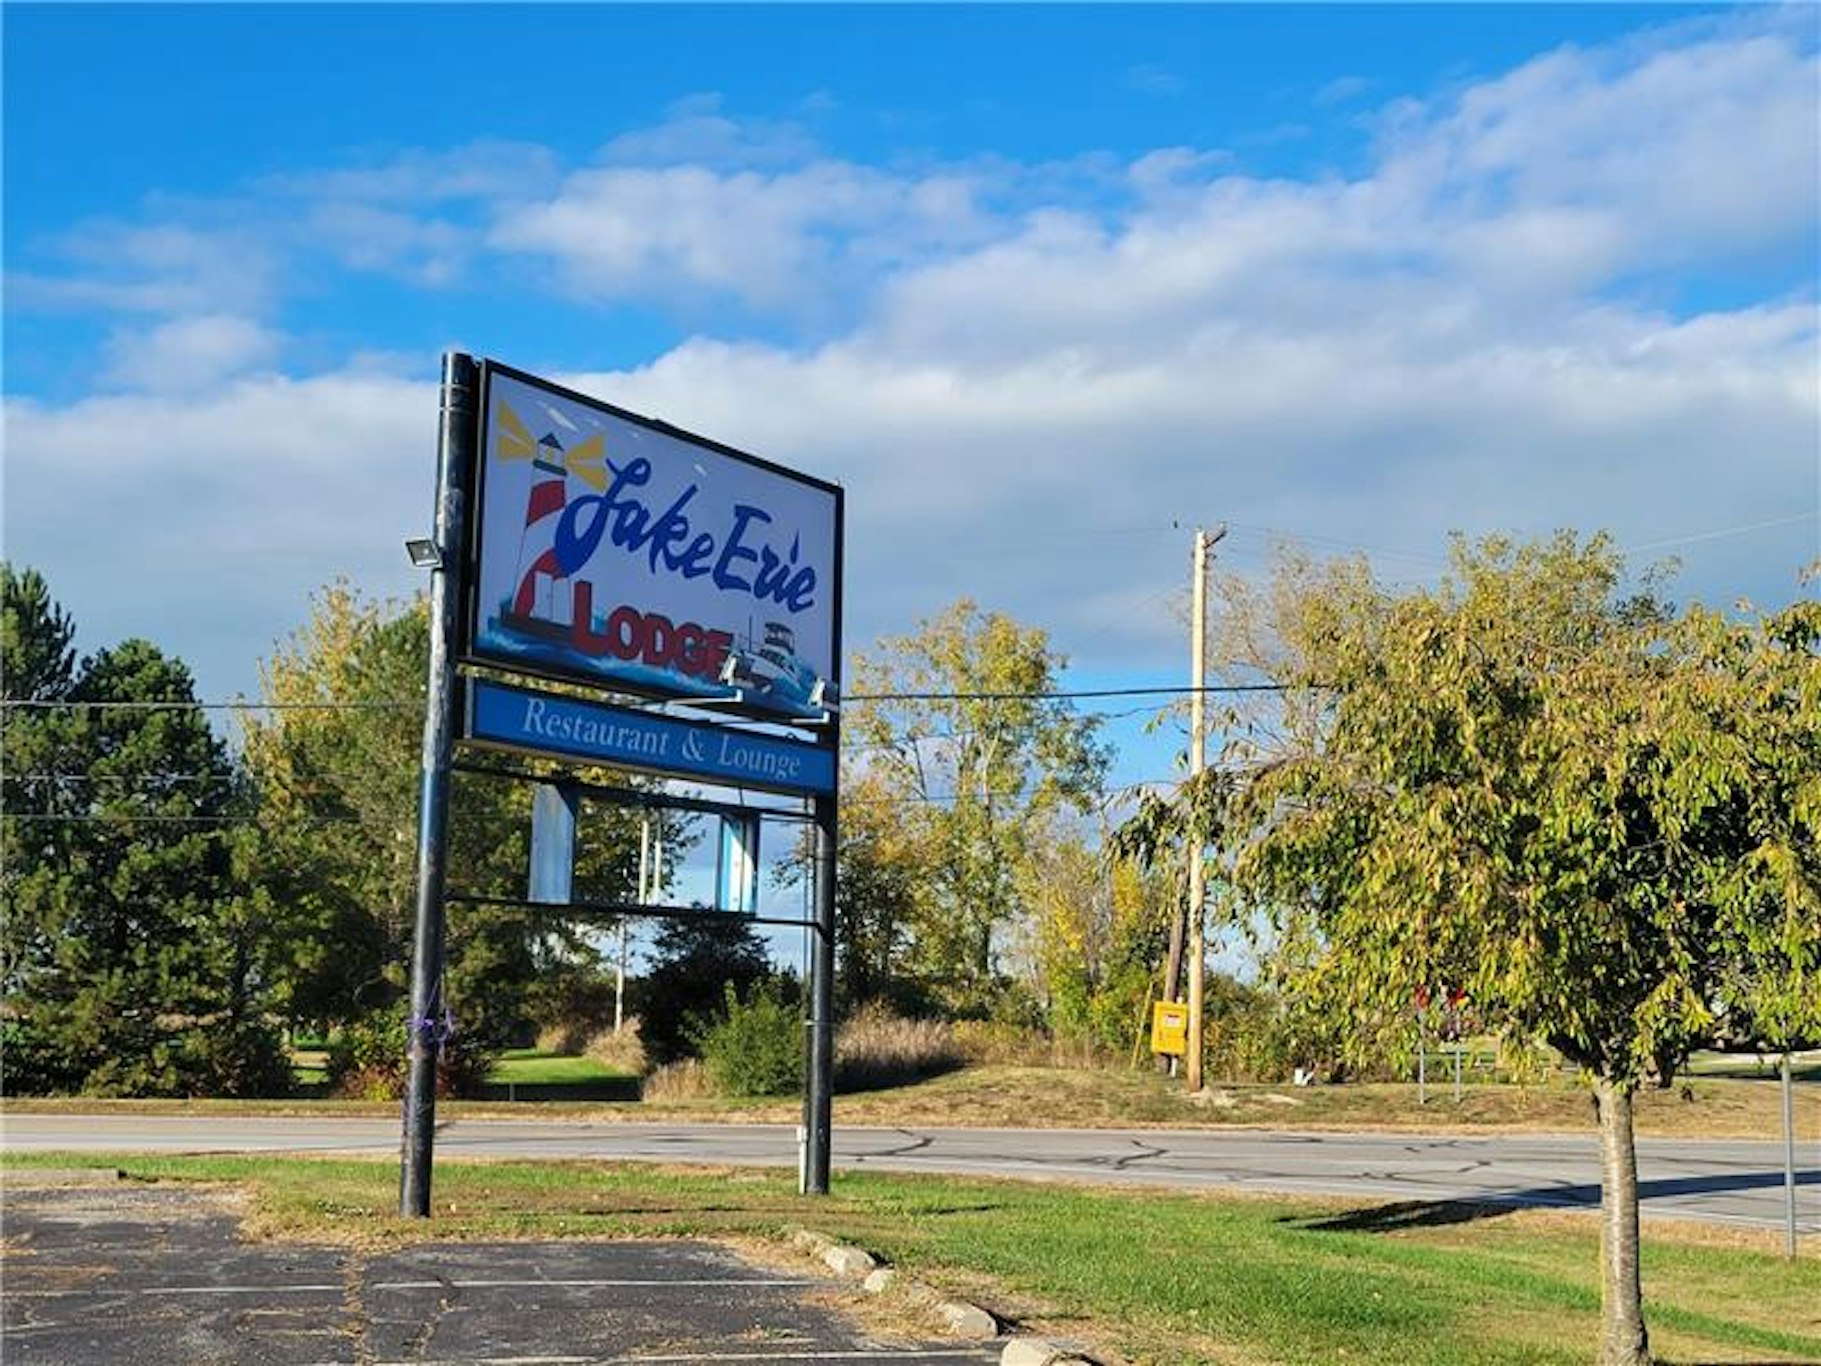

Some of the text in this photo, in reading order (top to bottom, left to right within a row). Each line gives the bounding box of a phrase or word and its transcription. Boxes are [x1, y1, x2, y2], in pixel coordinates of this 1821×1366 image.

[555, 457, 817, 612] Lake Erie
[570, 580, 735, 680] LODGE
[523, 697, 802, 779] Restaurant & Lounge
